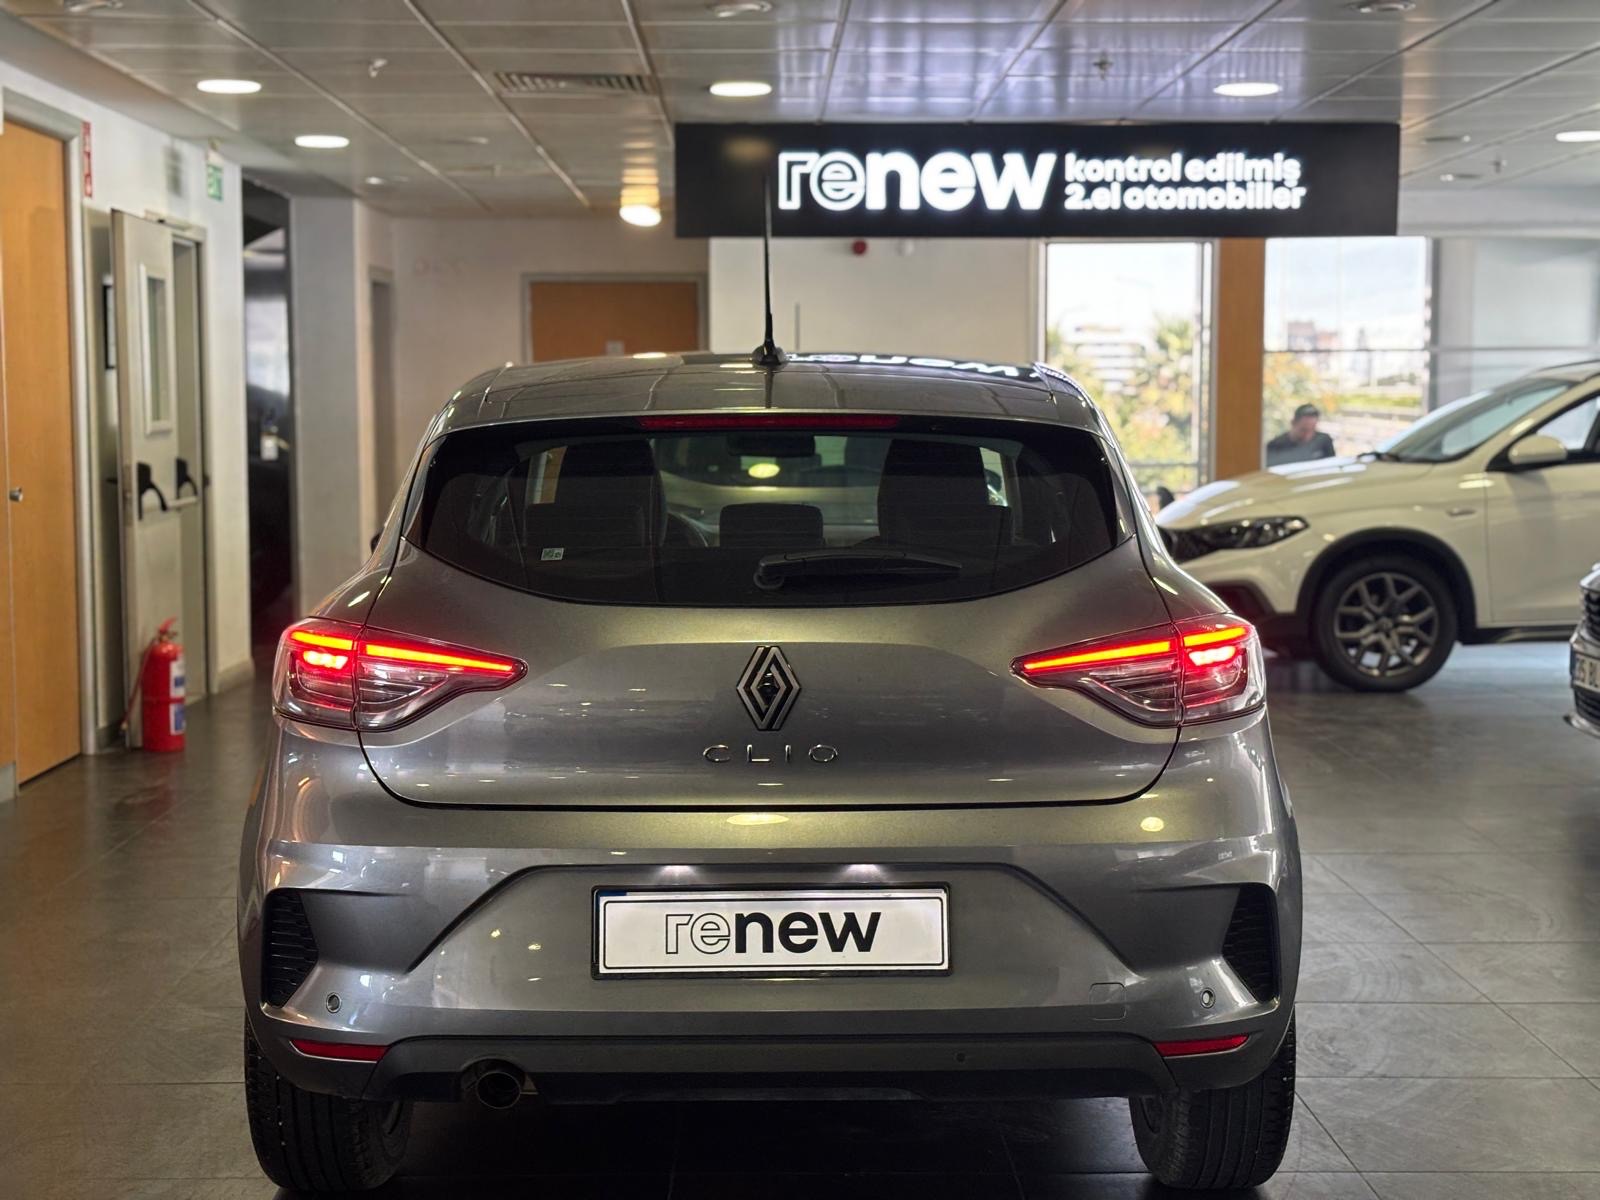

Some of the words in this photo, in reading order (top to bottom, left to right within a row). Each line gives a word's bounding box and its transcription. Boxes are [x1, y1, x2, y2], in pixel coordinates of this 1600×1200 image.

[778, 151, 1057, 212] renew
[1064, 152, 1182, 183] kontrol
[1184, 152, 1302, 188] edilmiş
[1064, 182, 1121, 211] 2.el
[1123, 183, 1307, 211] otomobiller
[702, 744, 838, 763] CLIO
[665, 911, 882, 955] renew
